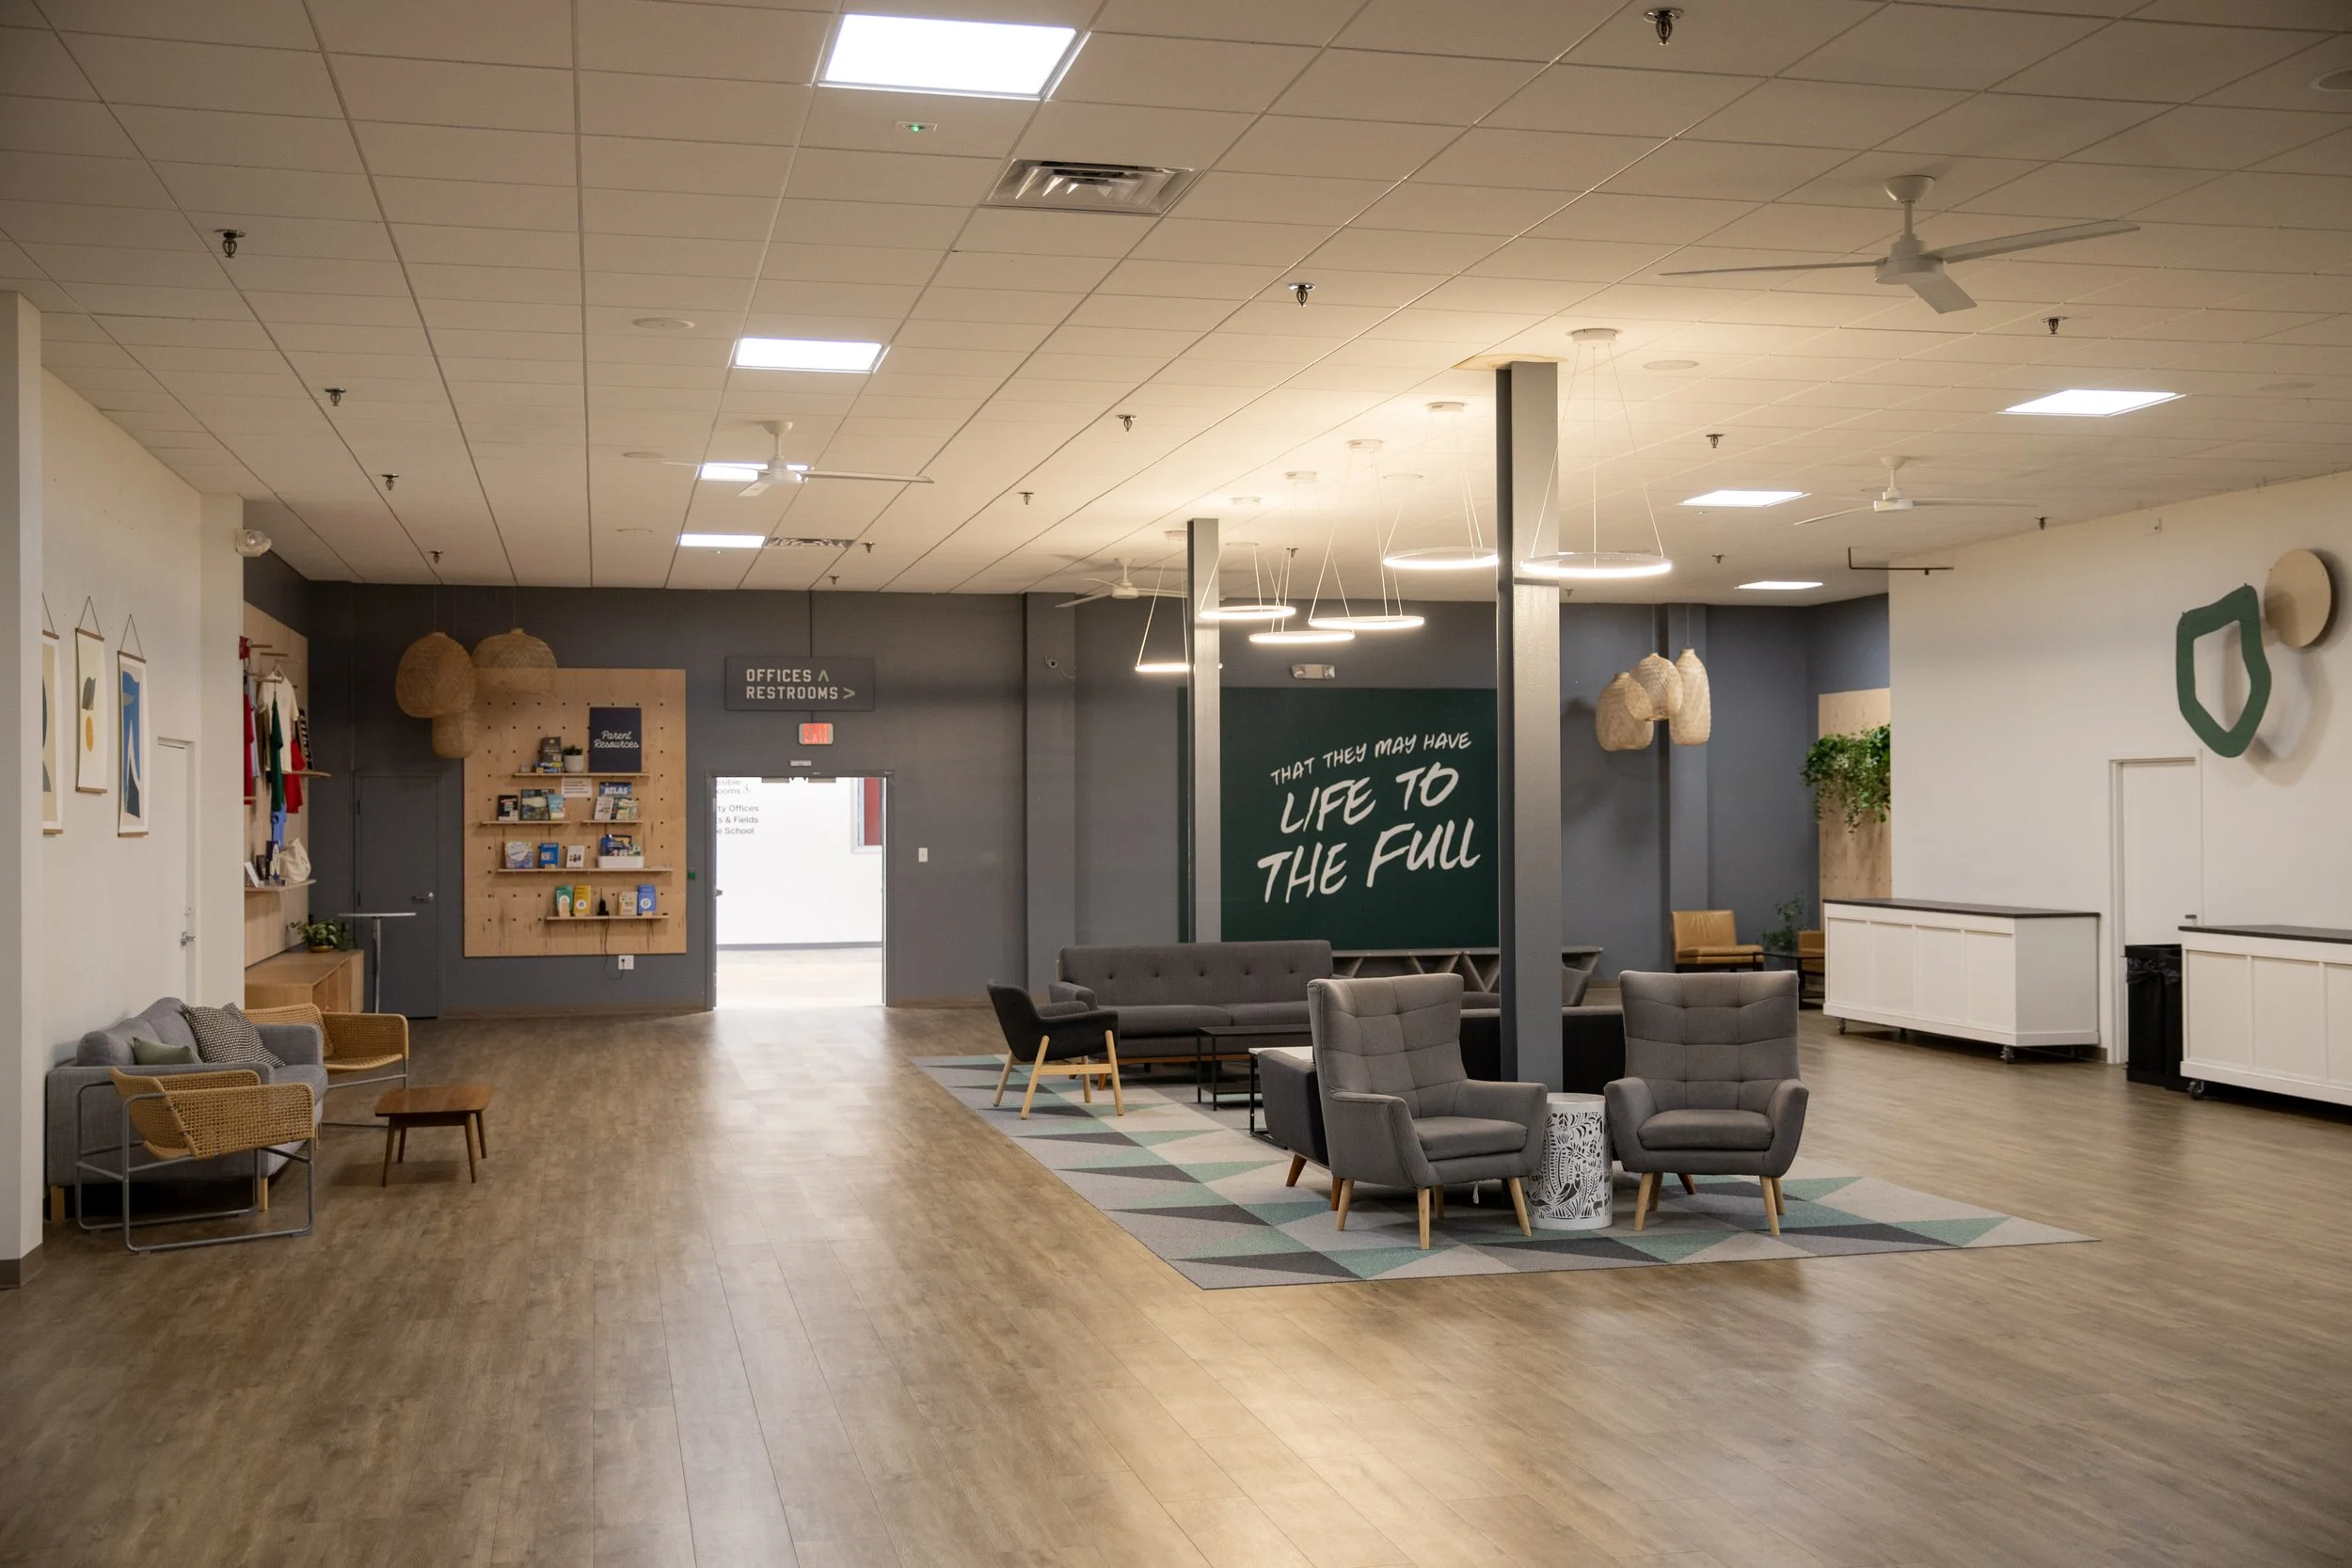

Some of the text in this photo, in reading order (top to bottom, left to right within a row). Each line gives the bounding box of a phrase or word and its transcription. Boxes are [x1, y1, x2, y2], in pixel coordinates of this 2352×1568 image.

[747, 669, 812, 682] OFFICES
[747, 686, 838, 700] RESTROOMS
[601, 730, 632, 740] Parent
[594, 739, 640, 749] Resources
[1270, 732, 1471, 785] THAT THEY MAY HAVE
[604, 786, 628, 795] ATLAS
[1280, 761, 1459, 834] LIFE TO
[728, 804, 759, 813] Offices
[733, 816, 759, 824] Fields
[724, 827, 755, 835] School
[1257, 817, 1481, 904] THE FULL
